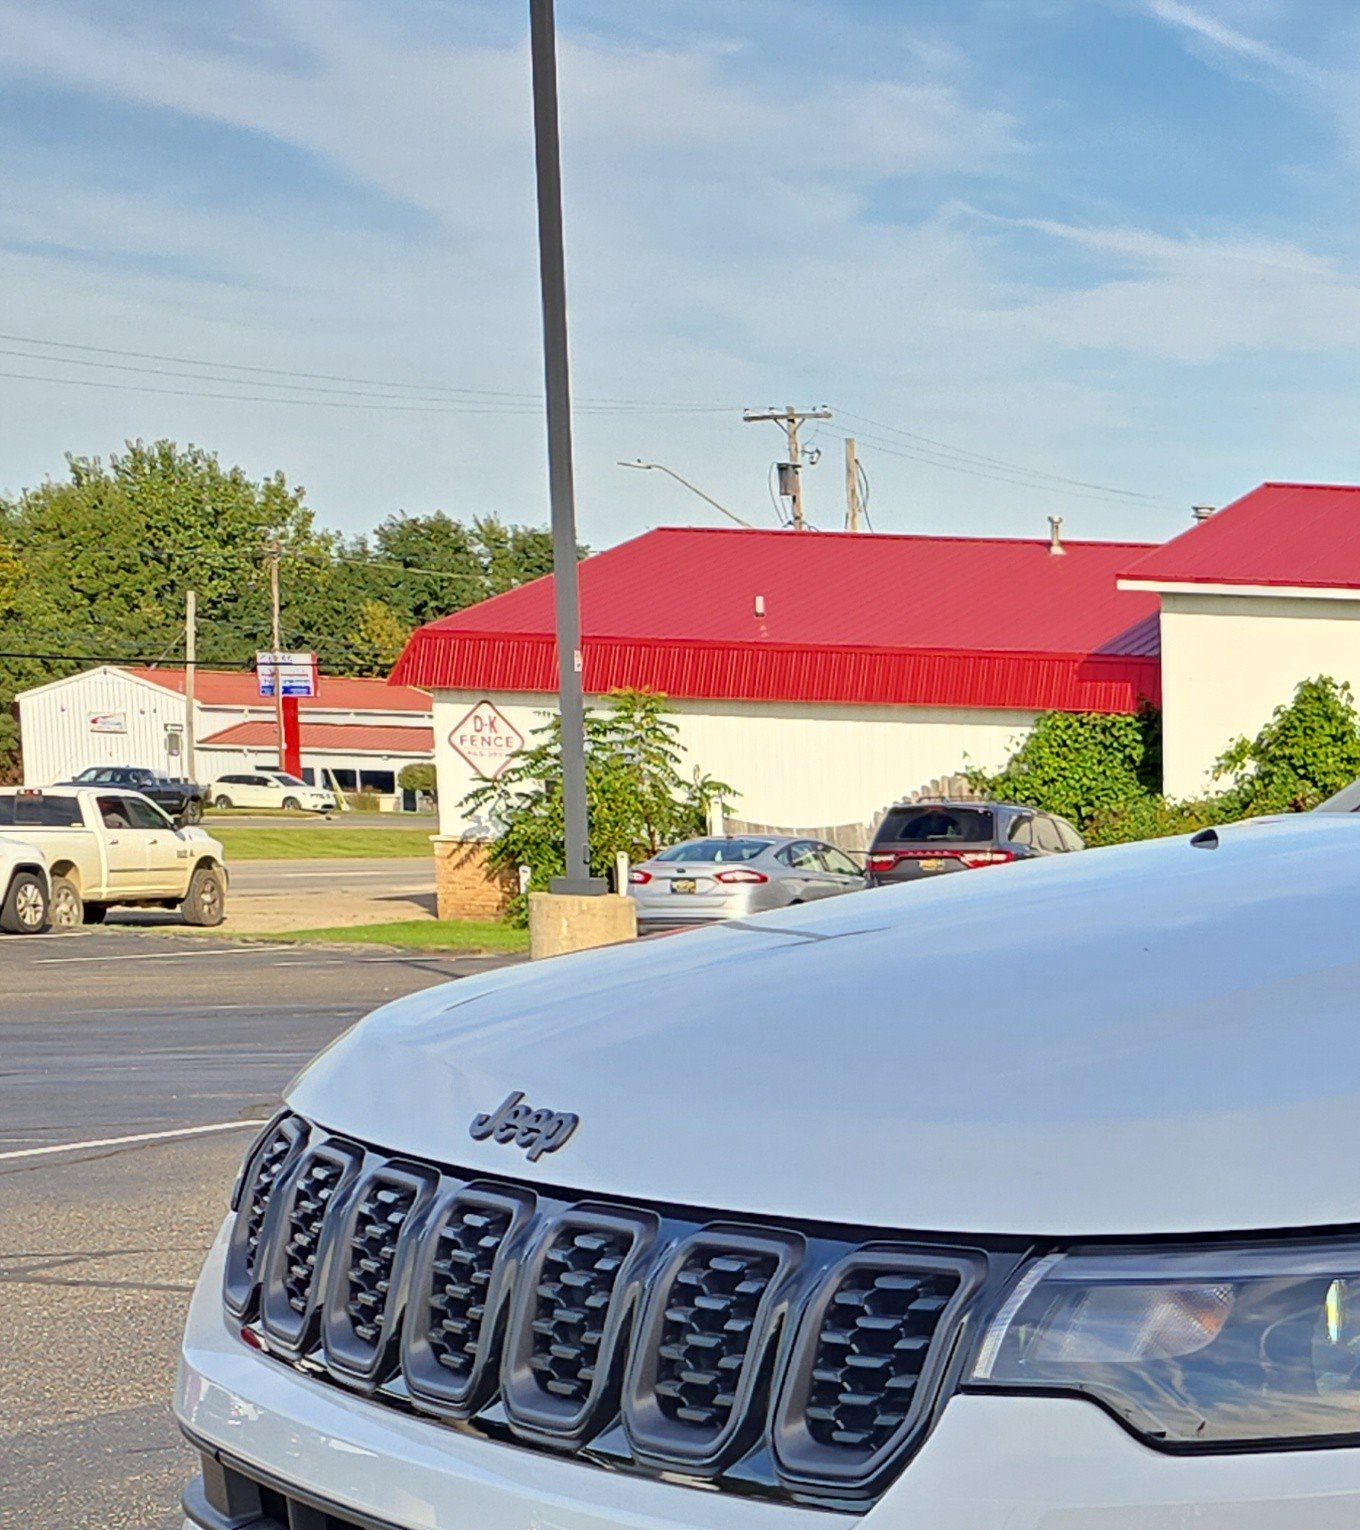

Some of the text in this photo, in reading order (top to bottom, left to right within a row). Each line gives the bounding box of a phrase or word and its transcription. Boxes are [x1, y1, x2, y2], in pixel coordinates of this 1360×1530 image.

[473, 714, 498, 733] D-K
[460, 734, 514, 748] FENCE
[469, 1090, 580, 1163] Jeep
